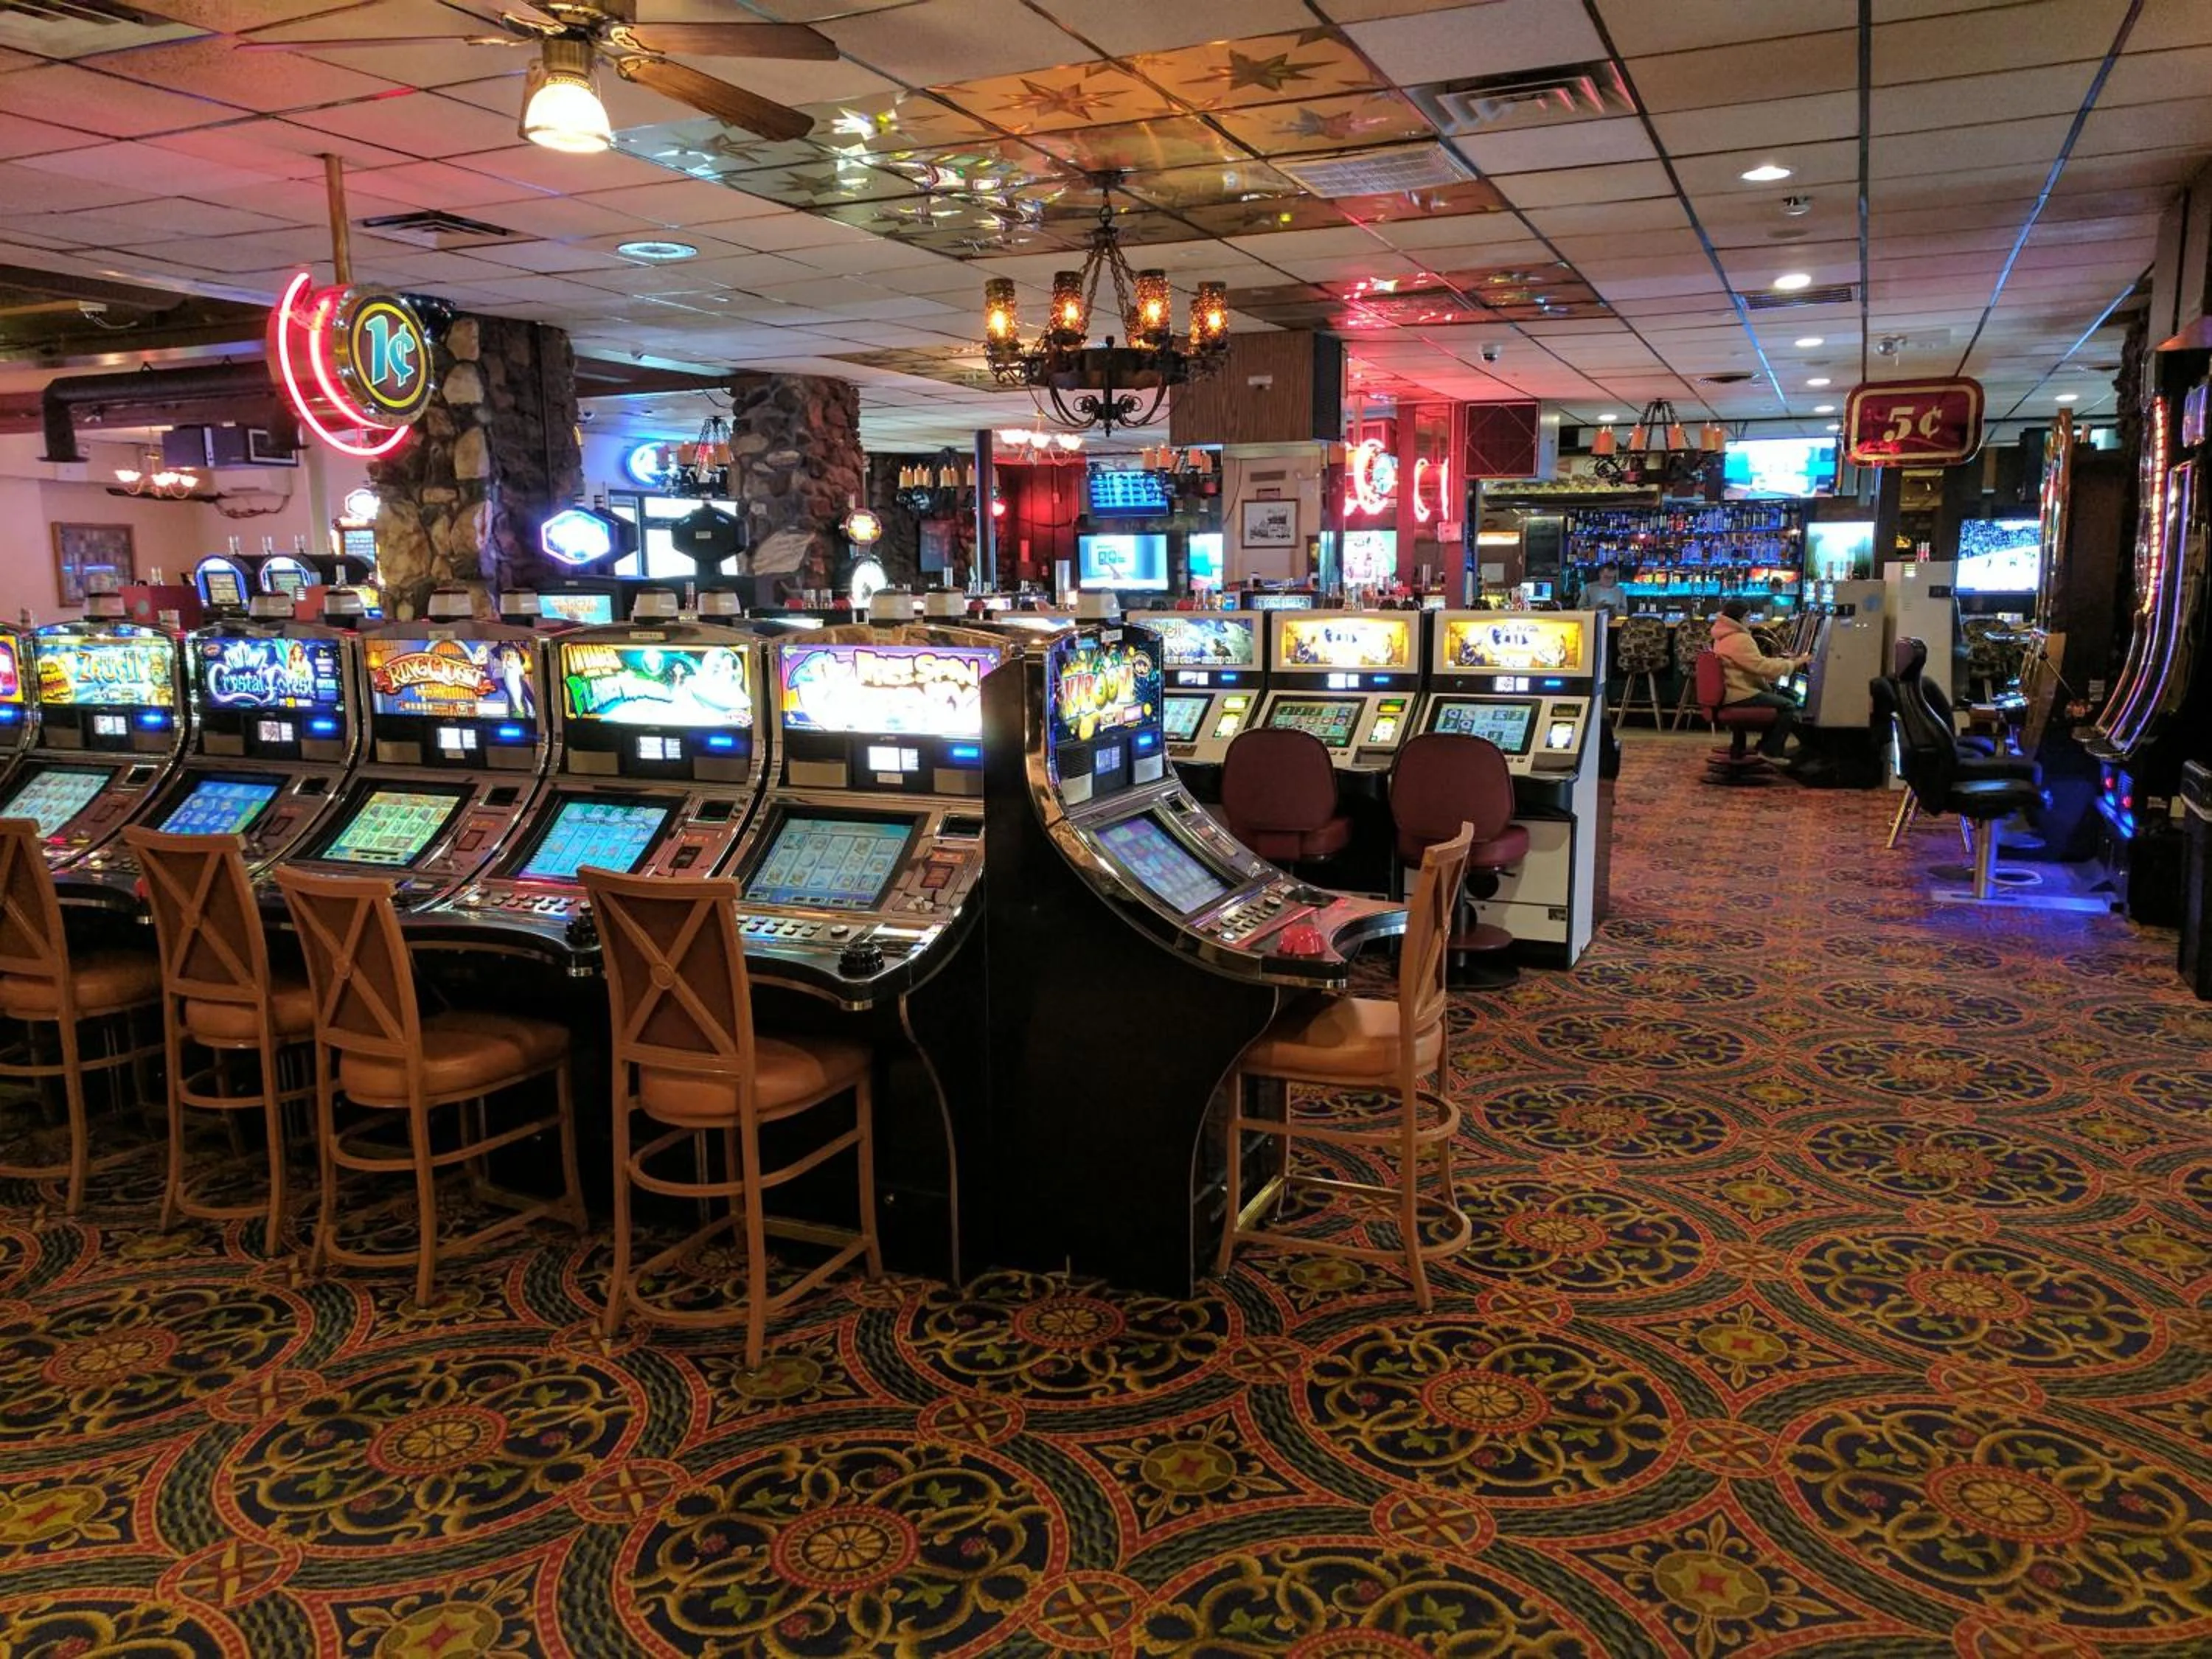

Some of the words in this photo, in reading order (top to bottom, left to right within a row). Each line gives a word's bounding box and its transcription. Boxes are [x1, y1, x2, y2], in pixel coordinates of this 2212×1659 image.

[365, 315, 415, 388] 1¢
[207, 663, 266, 703] Crystal
[262, 664, 316, 703] Forest
